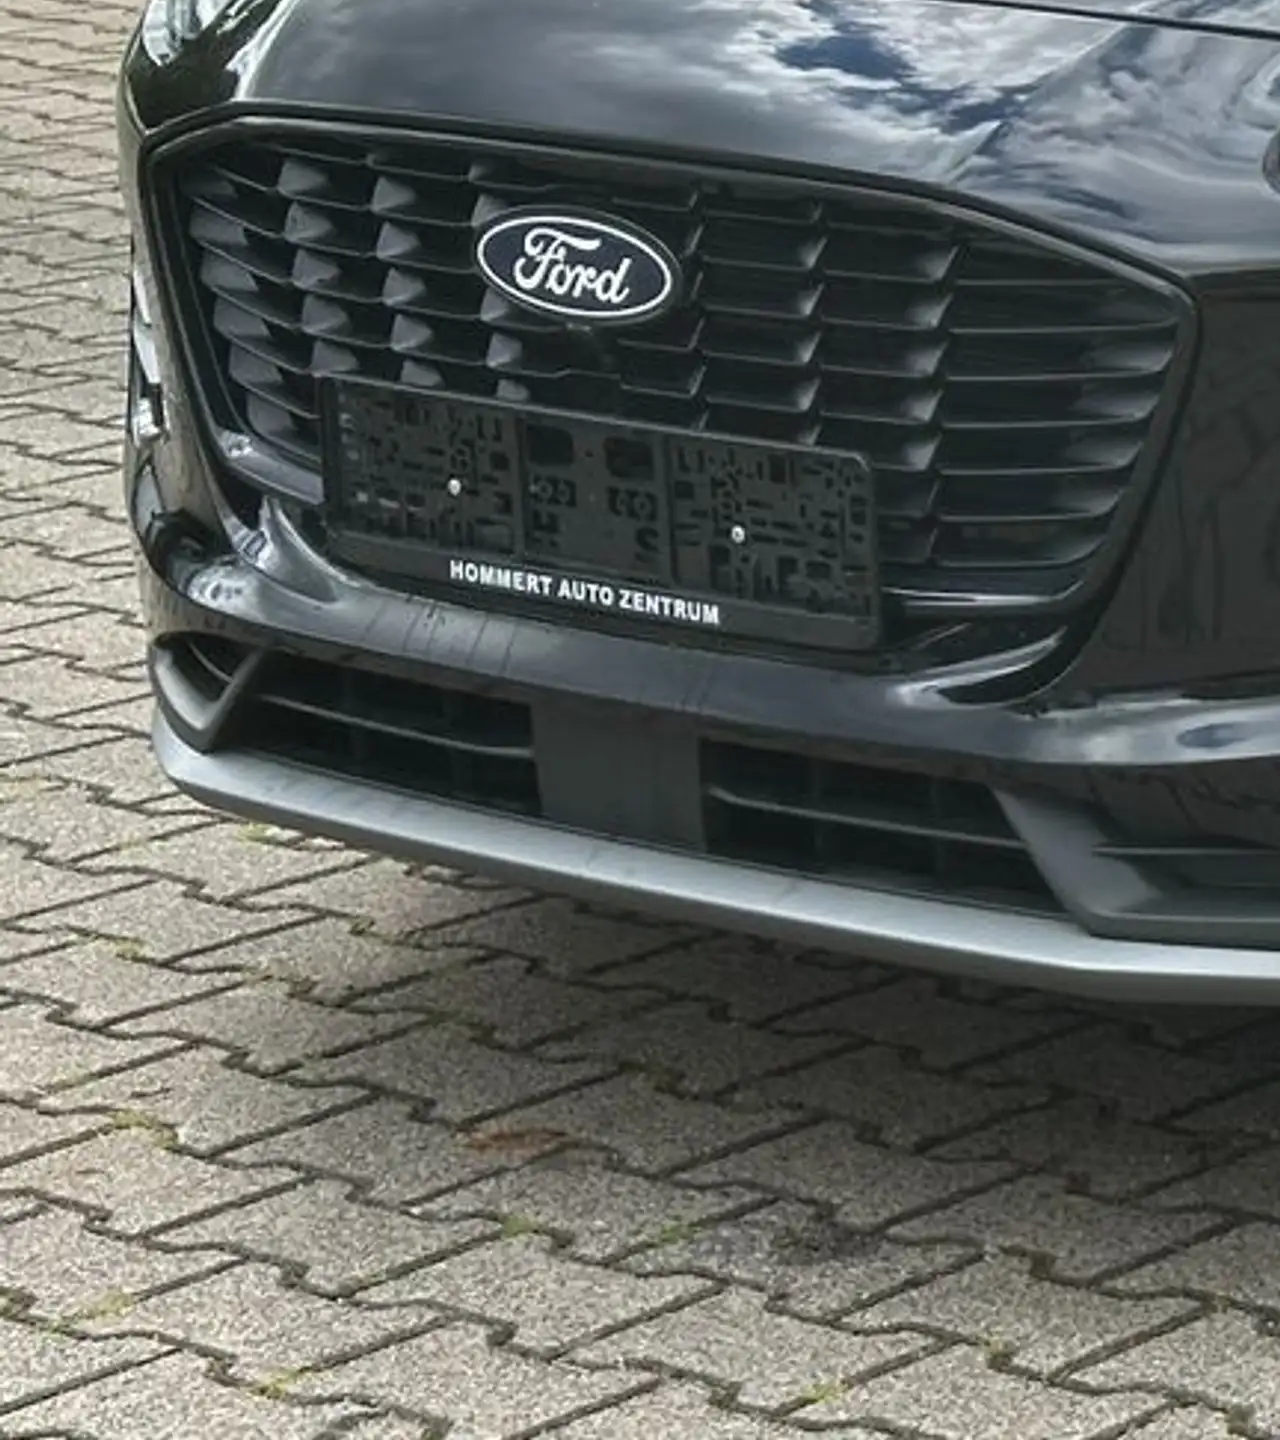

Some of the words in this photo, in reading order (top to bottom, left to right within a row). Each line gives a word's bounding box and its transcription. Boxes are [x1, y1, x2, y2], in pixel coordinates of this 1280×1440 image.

[513, 227, 632, 304] Ford
[449, 560, 552, 596] HOMMERT
[558, 578, 613, 606] AUTO
[618, 589, 720, 625] ZENTRUM
